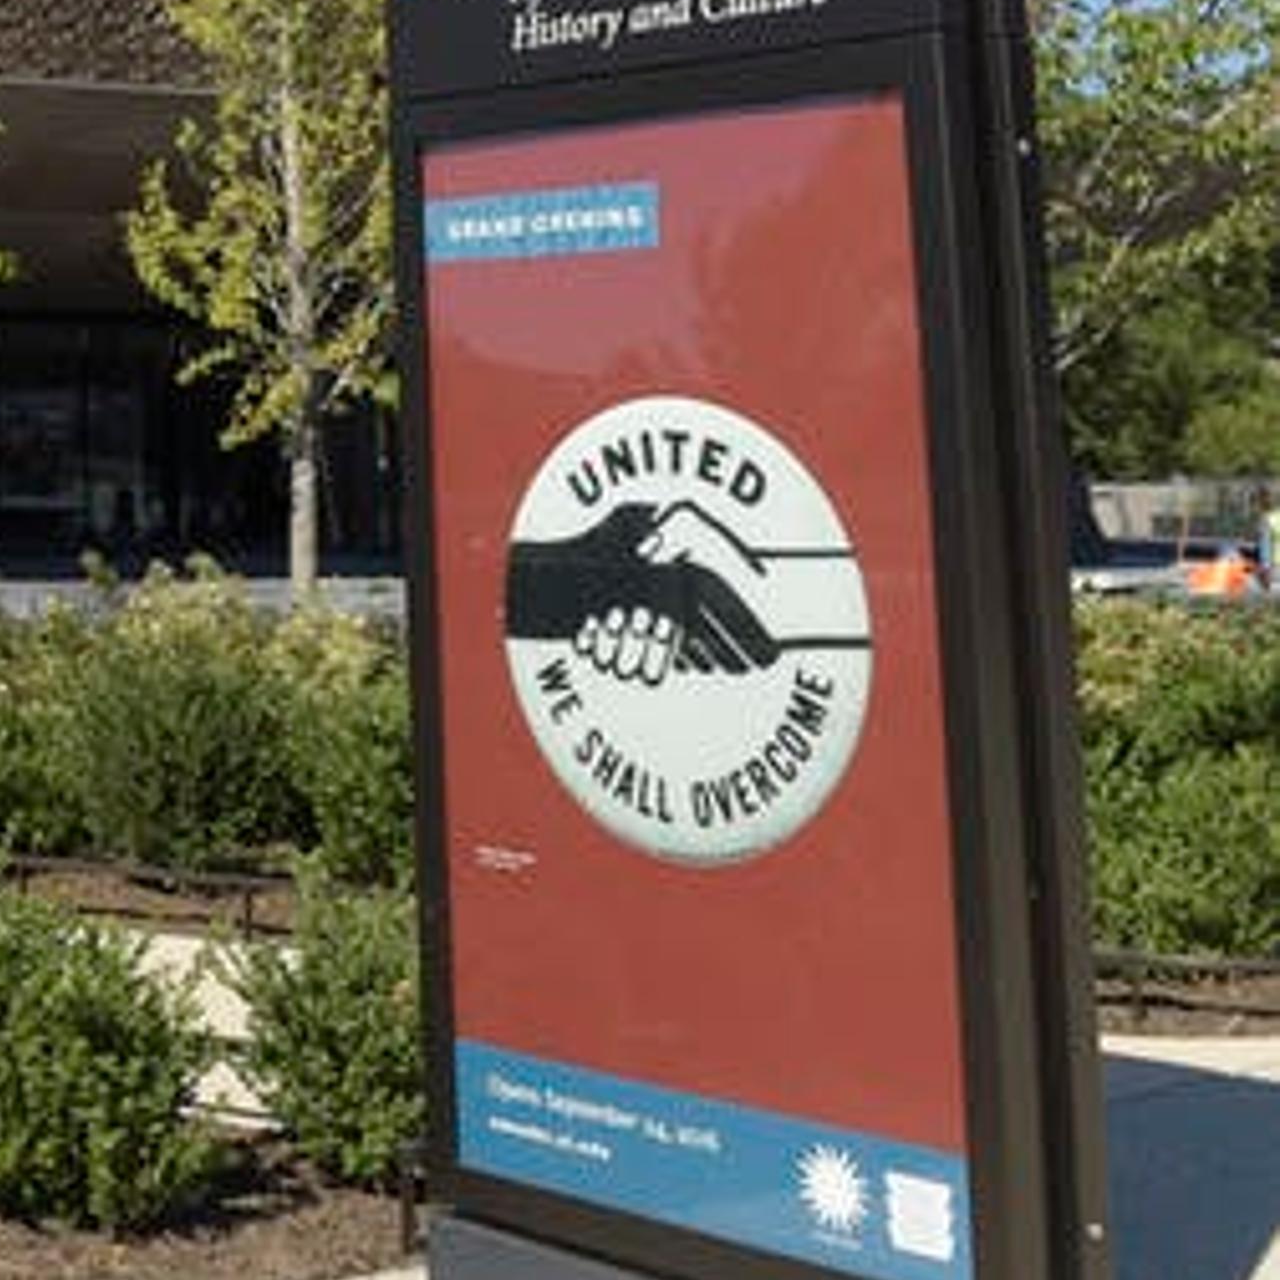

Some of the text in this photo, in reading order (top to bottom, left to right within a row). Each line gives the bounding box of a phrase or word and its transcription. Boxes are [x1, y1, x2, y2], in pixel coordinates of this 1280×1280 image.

[511, 10, 624, 52] History
[566, 428, 768, 508] UNITED
[536, 657, 836, 829] WE SHALL OVERCOME
